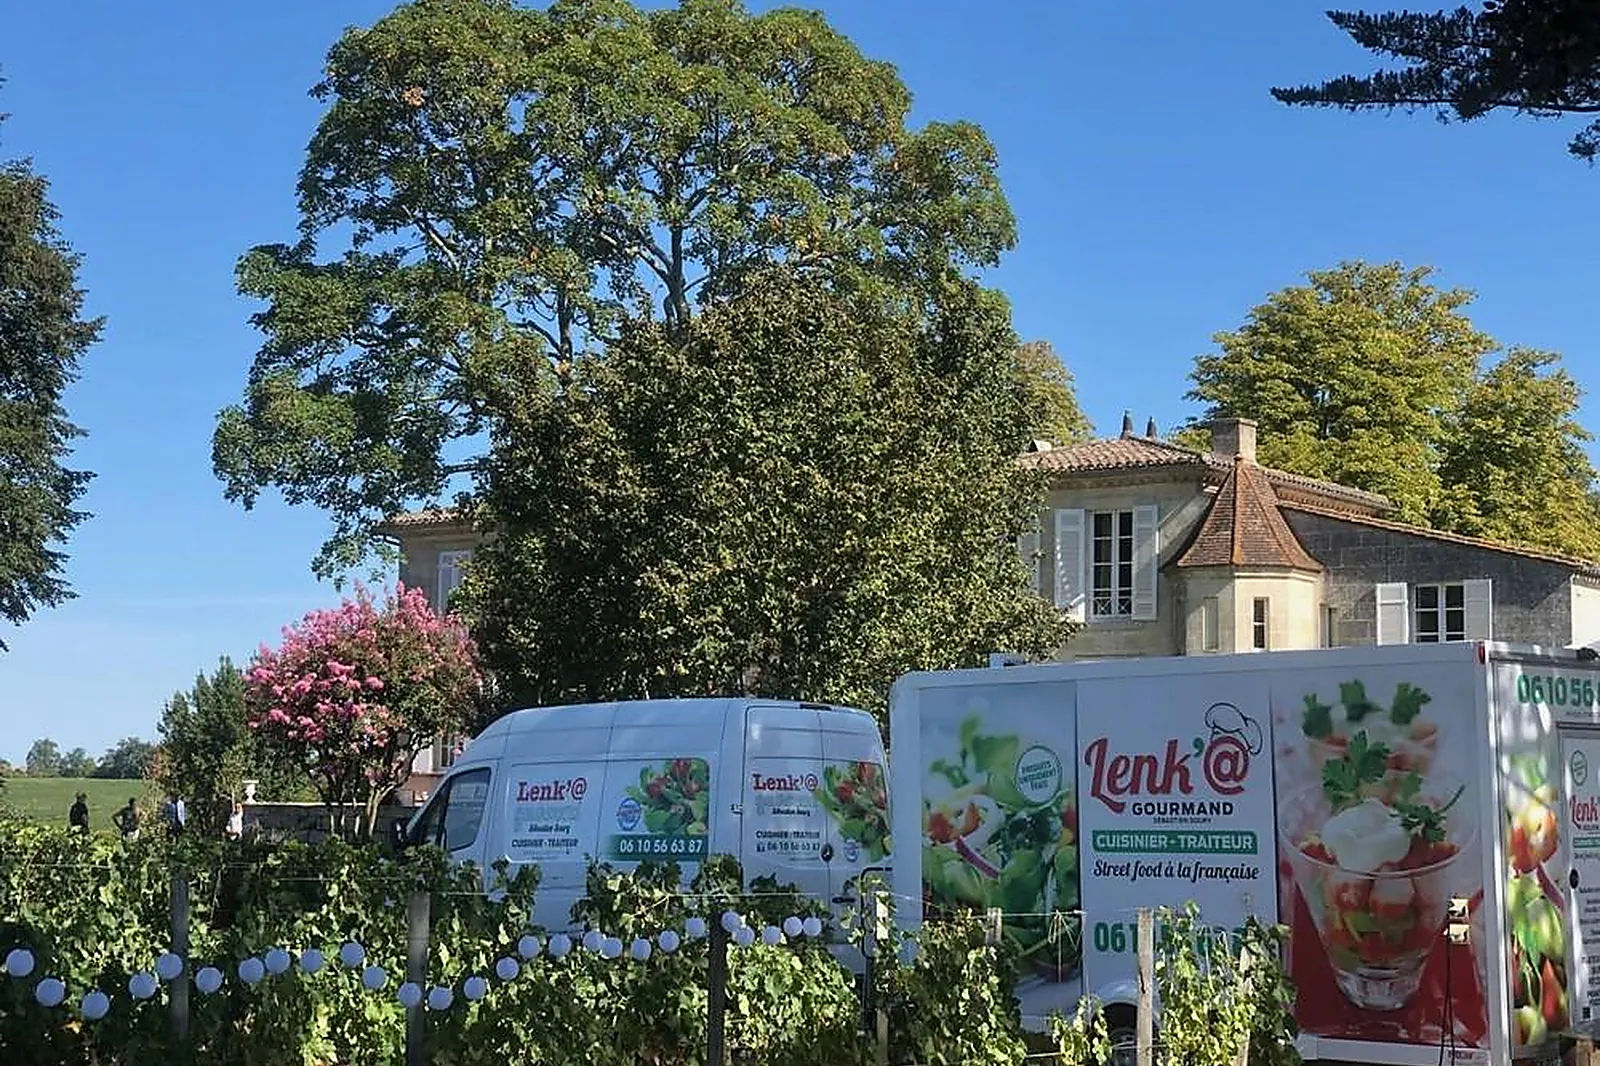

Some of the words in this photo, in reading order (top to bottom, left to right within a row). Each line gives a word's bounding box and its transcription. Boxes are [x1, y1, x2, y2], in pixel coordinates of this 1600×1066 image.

[752, 773, 818, 791] Lenk'@
[1085, 735, 1250, 813] Lenk'@
[516, 777, 587, 803] Lenk'@
[1132, 802, 1234, 816] GOURMAND
[620, 839, 634, 853] 06
[638, 839, 651, 853] 10
[654, 839, 668, 853] 56
[671, 839, 685, 853] 63
[688, 839, 703, 853] 87
[1094, 860, 1131, 877] Street
[1131, 860, 1162, 882] food
[1164, 861, 1175, 878] à
[1177, 862, 1190, 878] la
[1190, 861, 1260, 884] française
